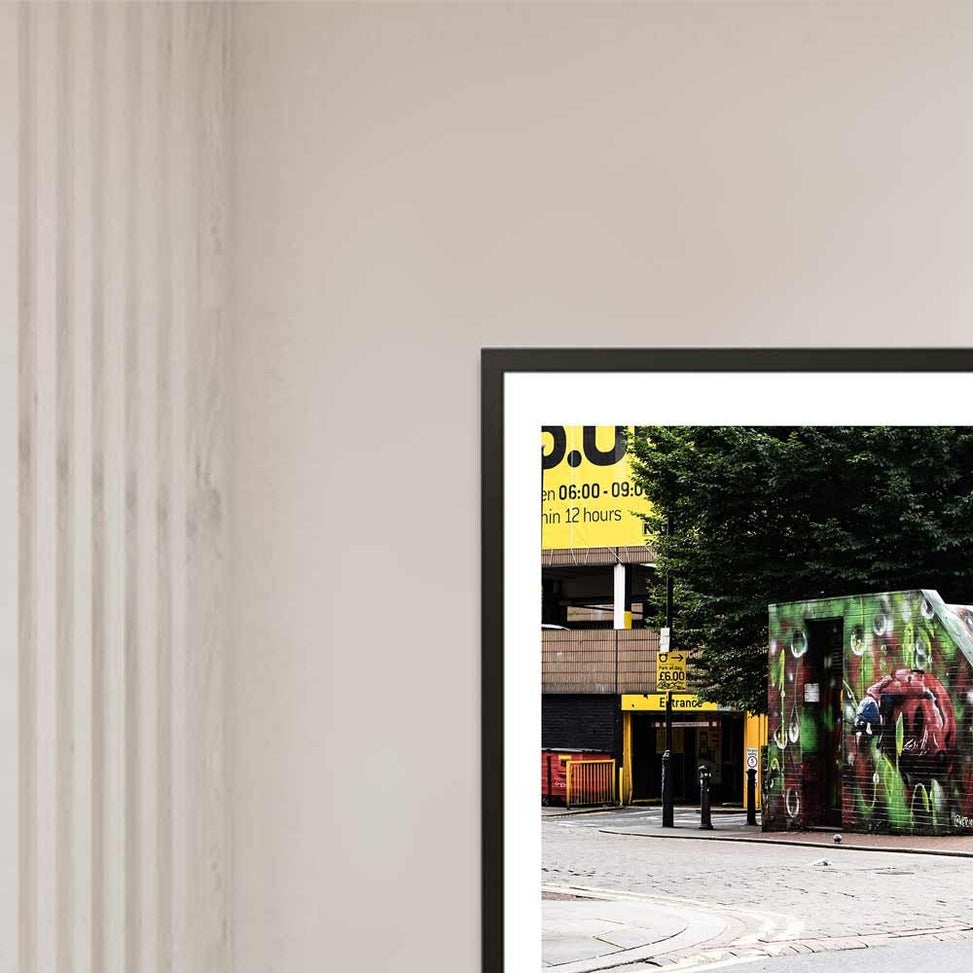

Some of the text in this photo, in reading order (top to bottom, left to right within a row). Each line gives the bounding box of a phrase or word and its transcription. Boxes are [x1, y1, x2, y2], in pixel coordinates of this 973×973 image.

[559, 483, 600, 500] 06:00
[565, 507, 580, 523] 12
[583, 507, 622, 522] hours
[659, 671, 685, 681] £6.00
